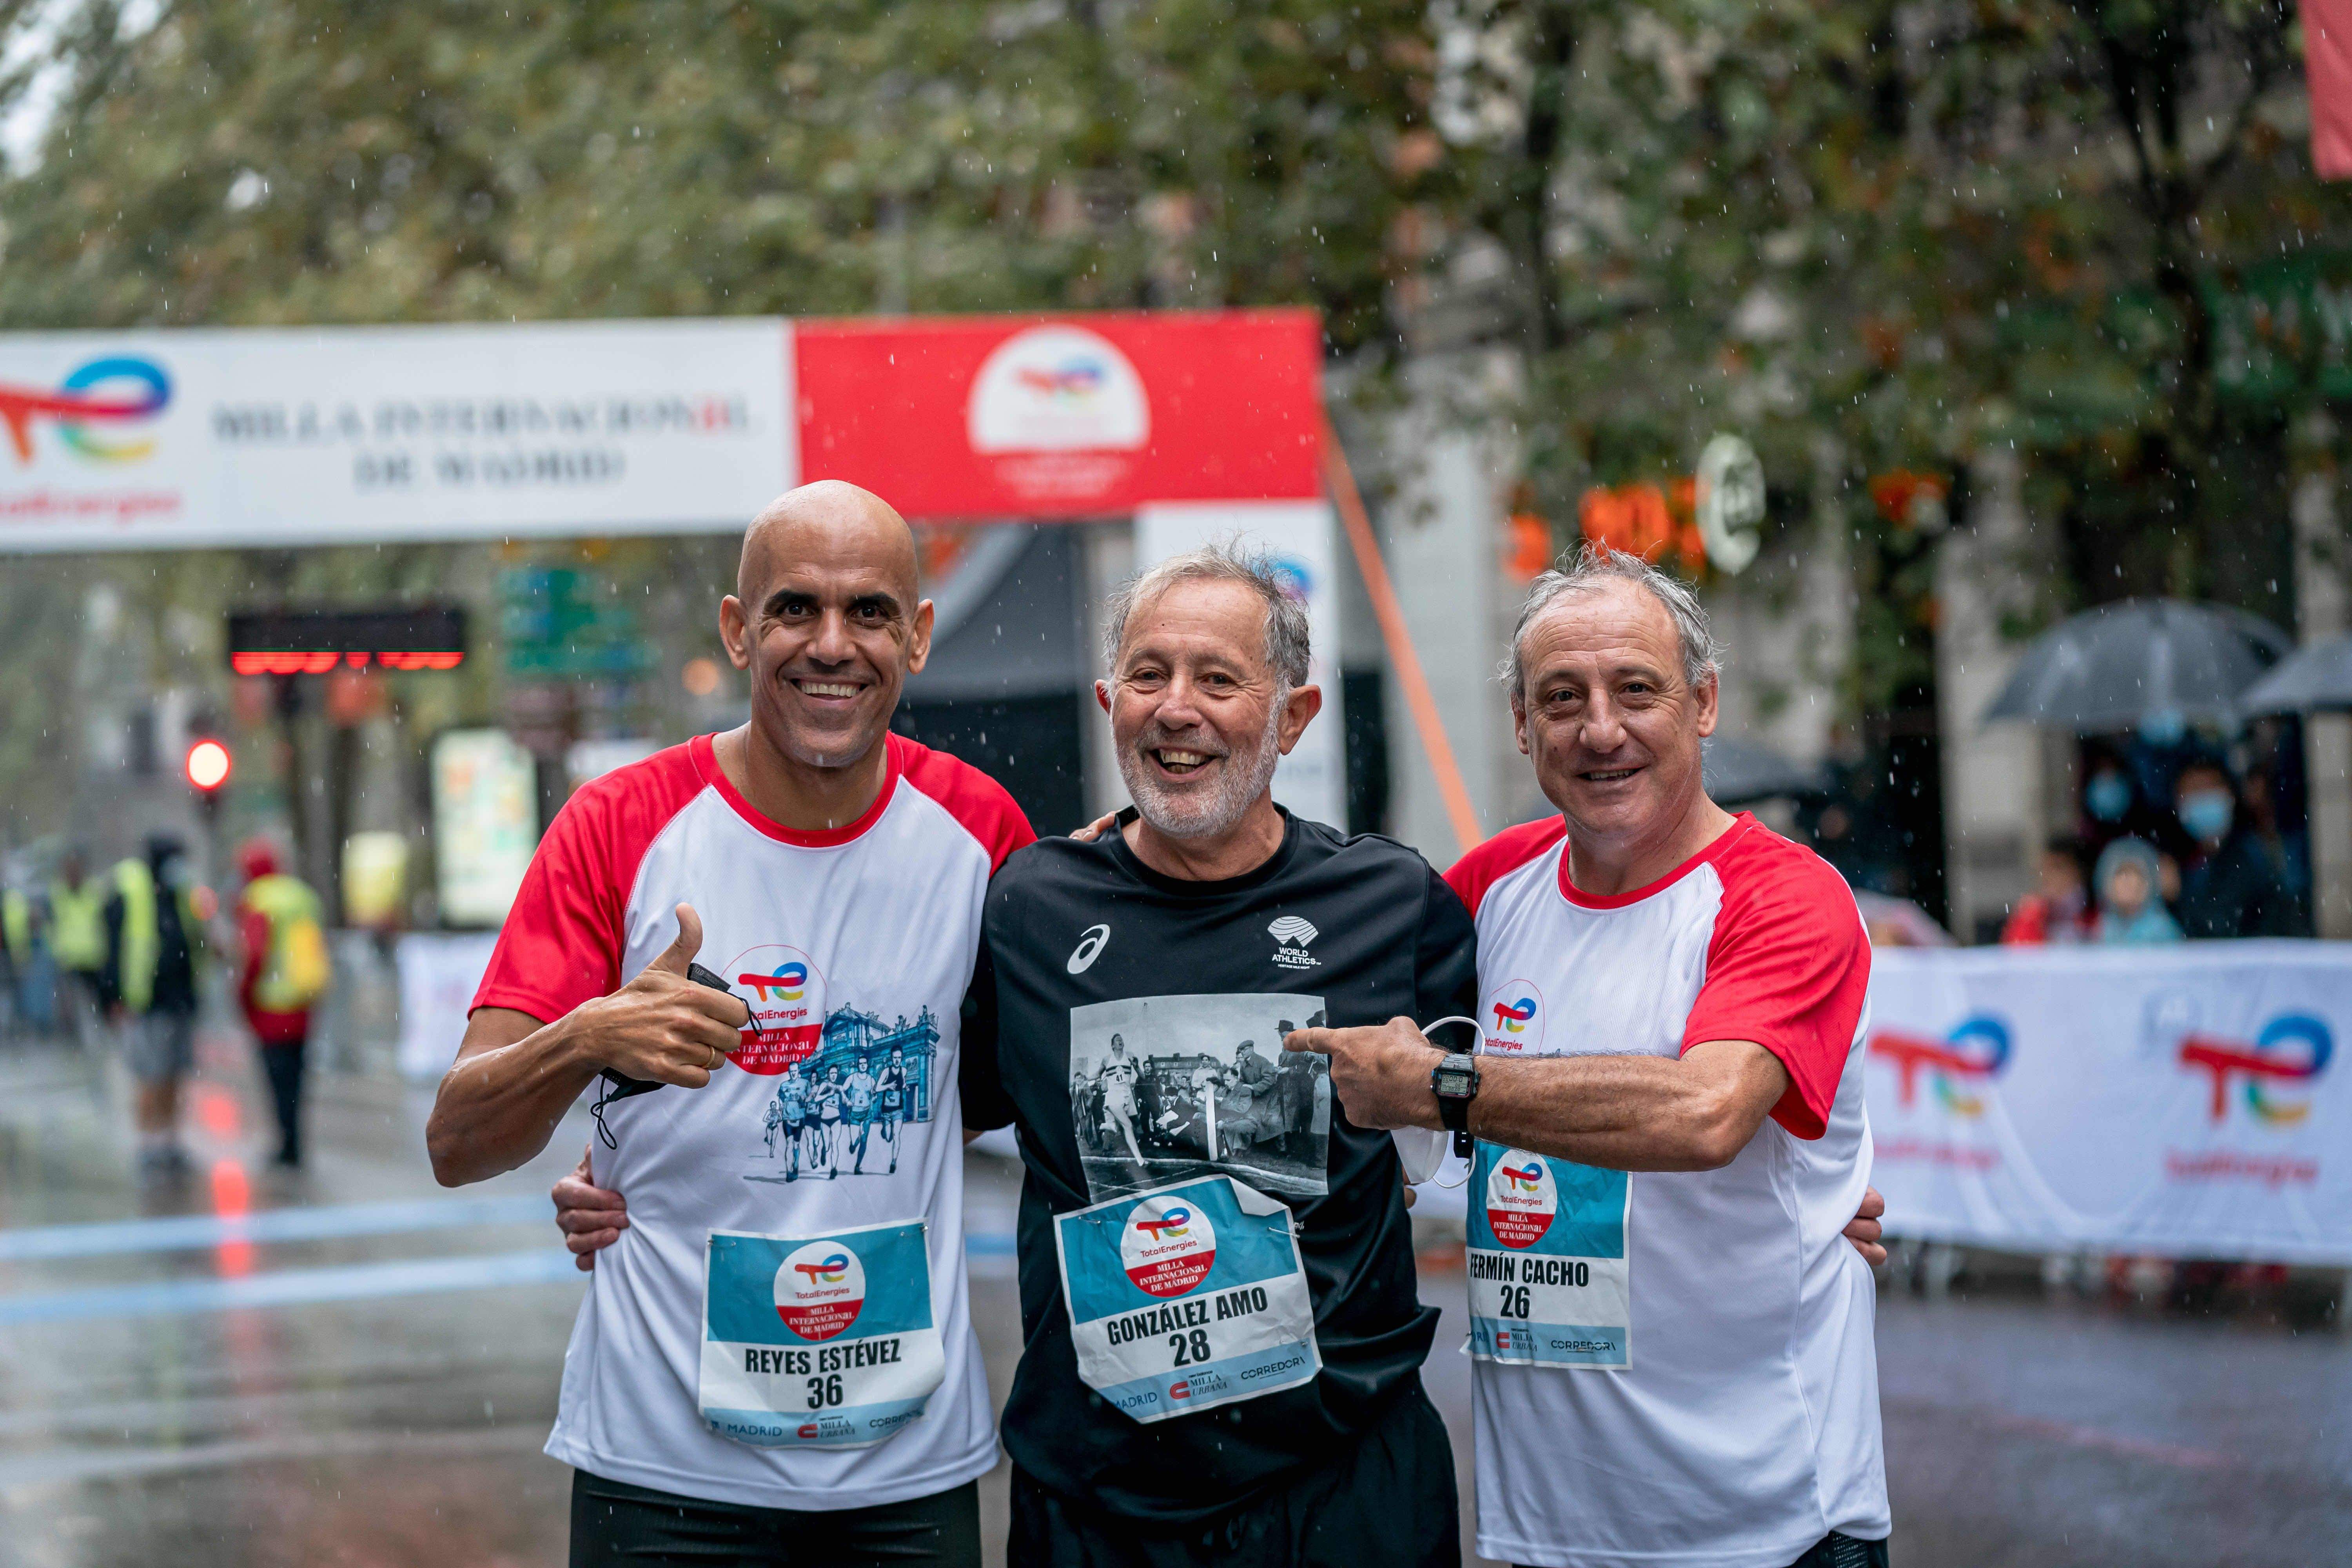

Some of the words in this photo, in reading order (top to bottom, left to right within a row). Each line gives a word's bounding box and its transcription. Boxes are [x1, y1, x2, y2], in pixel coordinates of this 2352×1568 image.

[1279, 947, 1308, 957] WORLD
[1272, 954, 1316, 965] ATHLETICS
[759, 1032, 790, 1042] MILLA
[742, 1055, 757, 1064] DE
[760, 1053, 800, 1064] MADRID
[1116, 1074, 1123, 1082] 41
[1501, 1195, 1543, 1206] TotalEnergies
[1508, 1214, 1528, 1222] MILLA
[1509, 1232, 1535, 1240] MADRID
[1140, 1240, 1197, 1258] TotalEnergies
[1157, 1260, 1185, 1272] MILLA
[1470, 1252, 1515, 1282] FERMÍN
[1523, 1258, 1589, 1287] CACHO
[1151, 1283, 1163, 1292] DE
[1164, 1275, 1198, 1289] MADRID
[795, 1287, 850, 1299] TotalEnergies
[1501, 1285, 1530, 1318] 26
[811, 1305, 834, 1315] MILLA
[1107, 1300, 1210, 1346] GONZÁLEZ
[1216, 1287, 1268, 1320] AMO
[800, 1326, 813, 1334] DE
[813, 1321, 845, 1332] MADRID
[1511, 1333, 1533, 1341] MILLA
[1169, 1328, 1211, 1367] 28
[746, 1348, 811, 1375] REYES
[819, 1337, 901, 1372] ESTÉVEZ
[1191, 1374, 1221, 1387] MILLA
[807, 1374, 844, 1409] 36
[1192, 1381, 1228, 1396] URBANA
[728, 1423, 782, 1437] MADRID
[820, 1419, 851, 1430] MILLA
